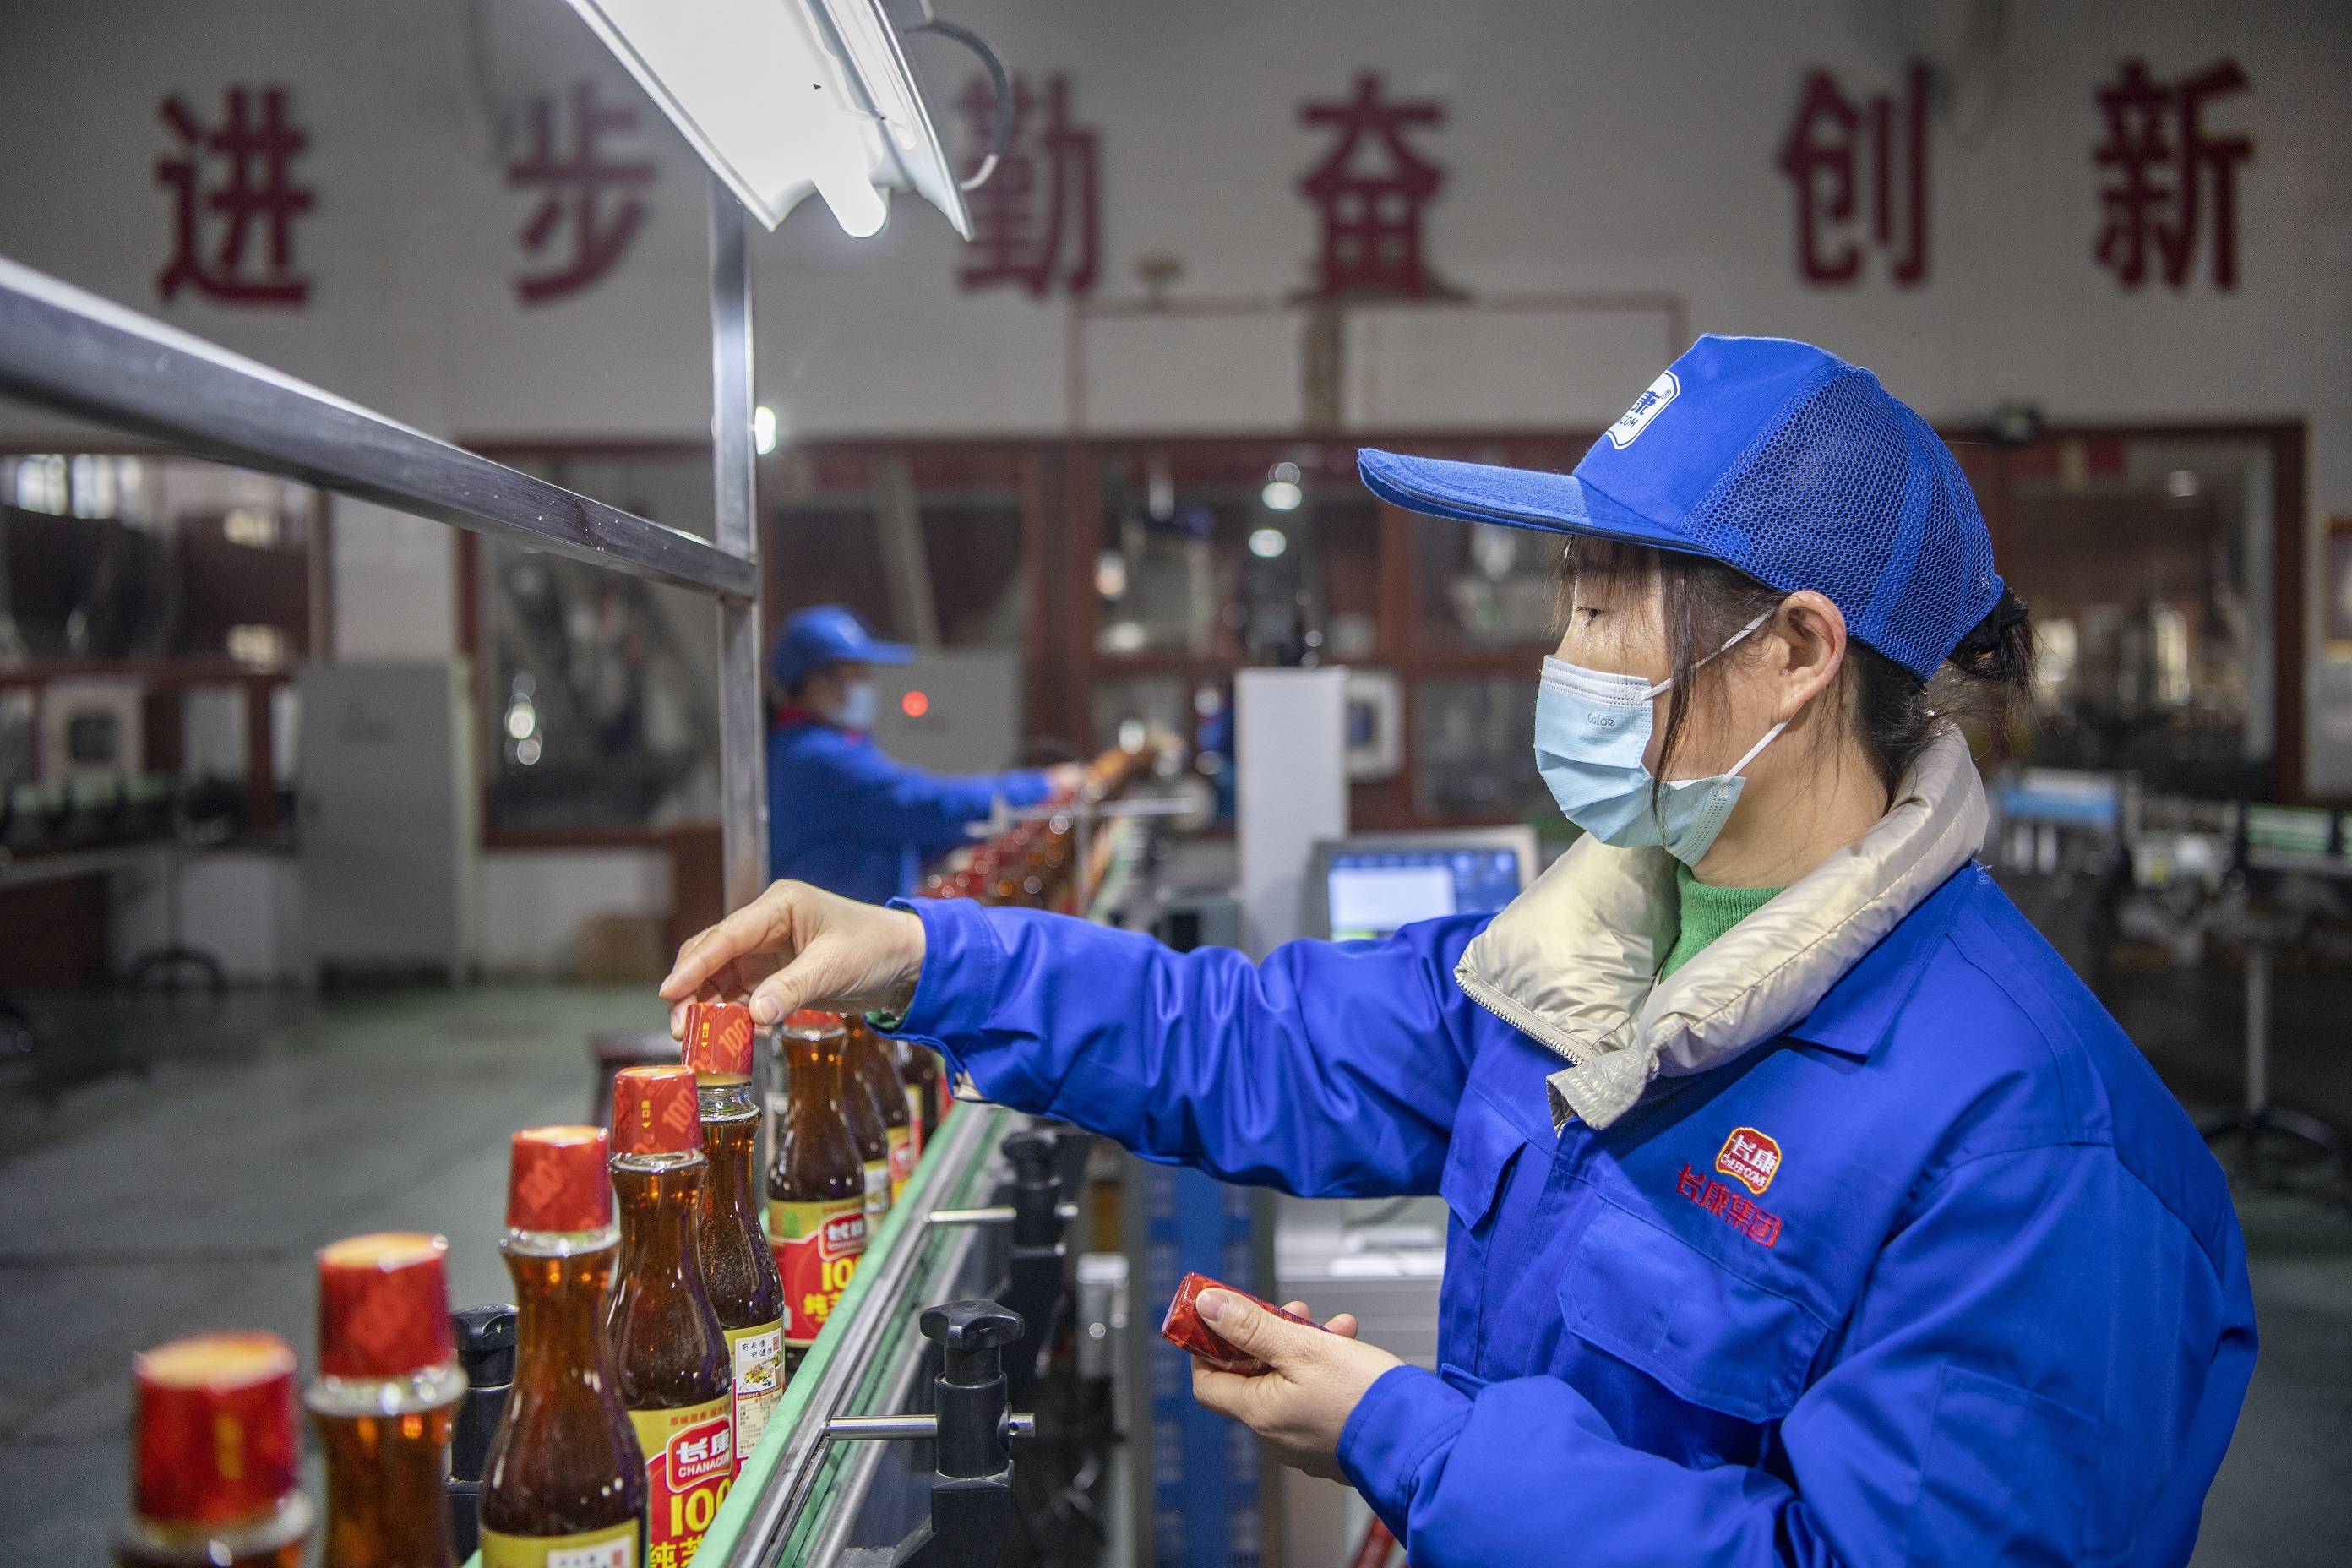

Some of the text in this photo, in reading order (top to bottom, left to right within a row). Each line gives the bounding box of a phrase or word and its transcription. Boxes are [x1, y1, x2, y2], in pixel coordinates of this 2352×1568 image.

[1587, 713, 1616, 727] Cofoe
[1732, 1135, 1777, 1175] 长康
[1676, 1162, 1782, 1249] 长康集团
[676, 1428, 730, 1464] 长康
